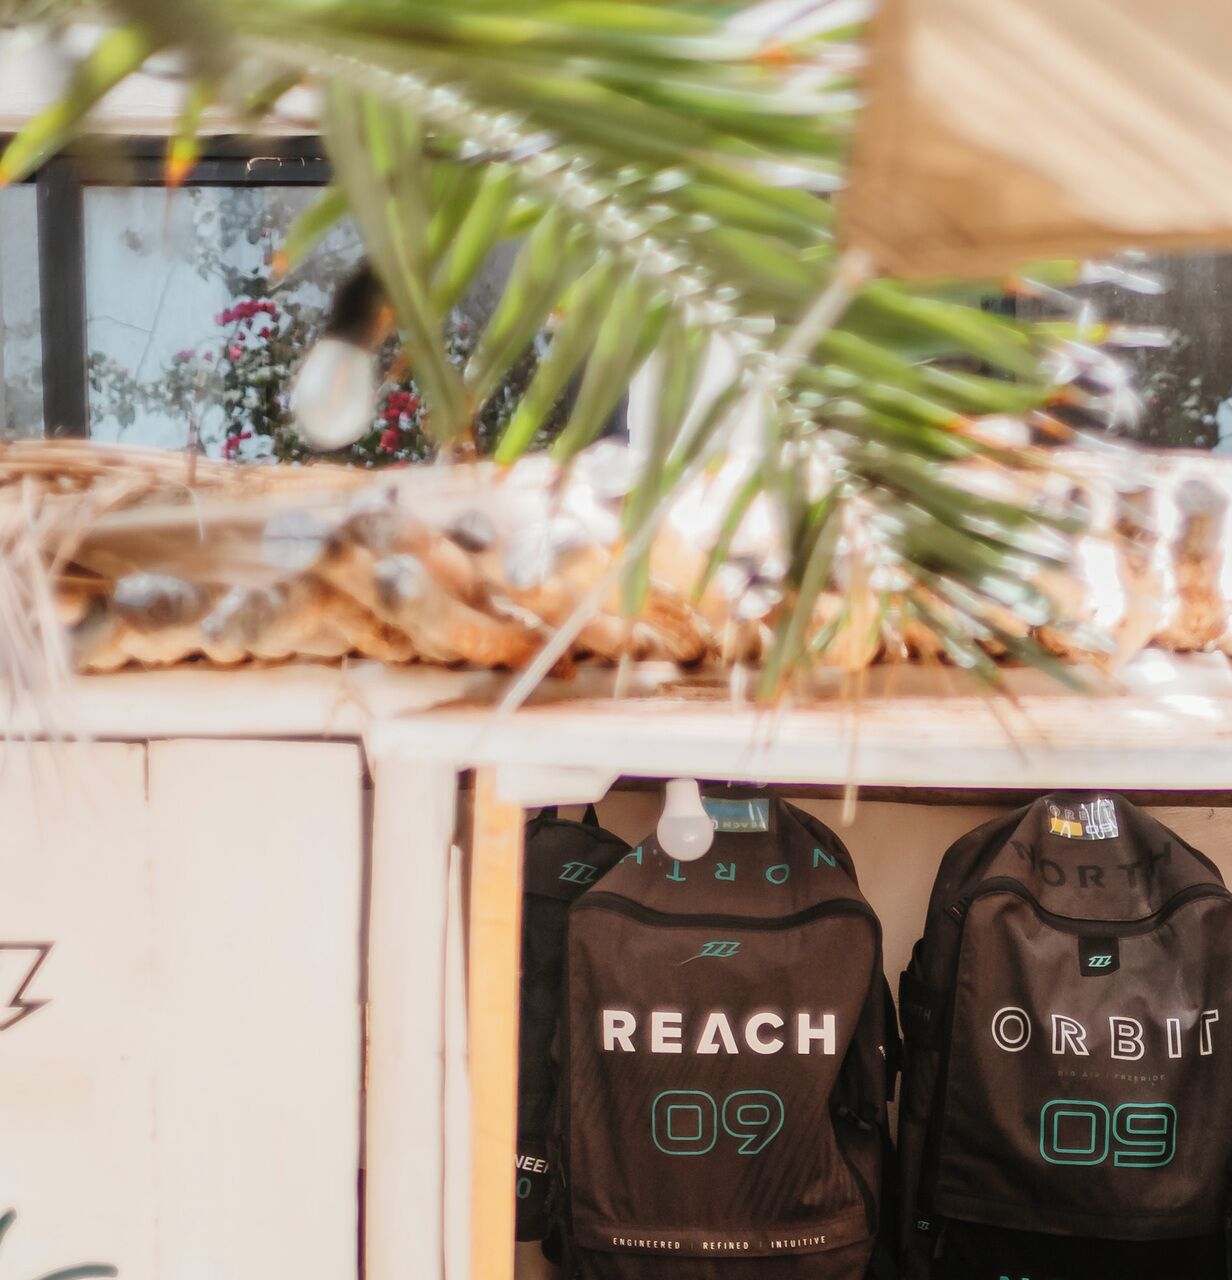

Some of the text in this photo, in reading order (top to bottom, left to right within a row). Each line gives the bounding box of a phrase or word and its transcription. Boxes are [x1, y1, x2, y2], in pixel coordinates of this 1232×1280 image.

[603, 1009, 836, 1055] REACH
[991, 1006, 1219, 1061] ORBIT
[652, 1089, 785, 1156] 09
[1039, 1099, 1177, 1168] 09
[613, 1235, 826, 1250] ENGINEERED REFINED INTUITIVE
